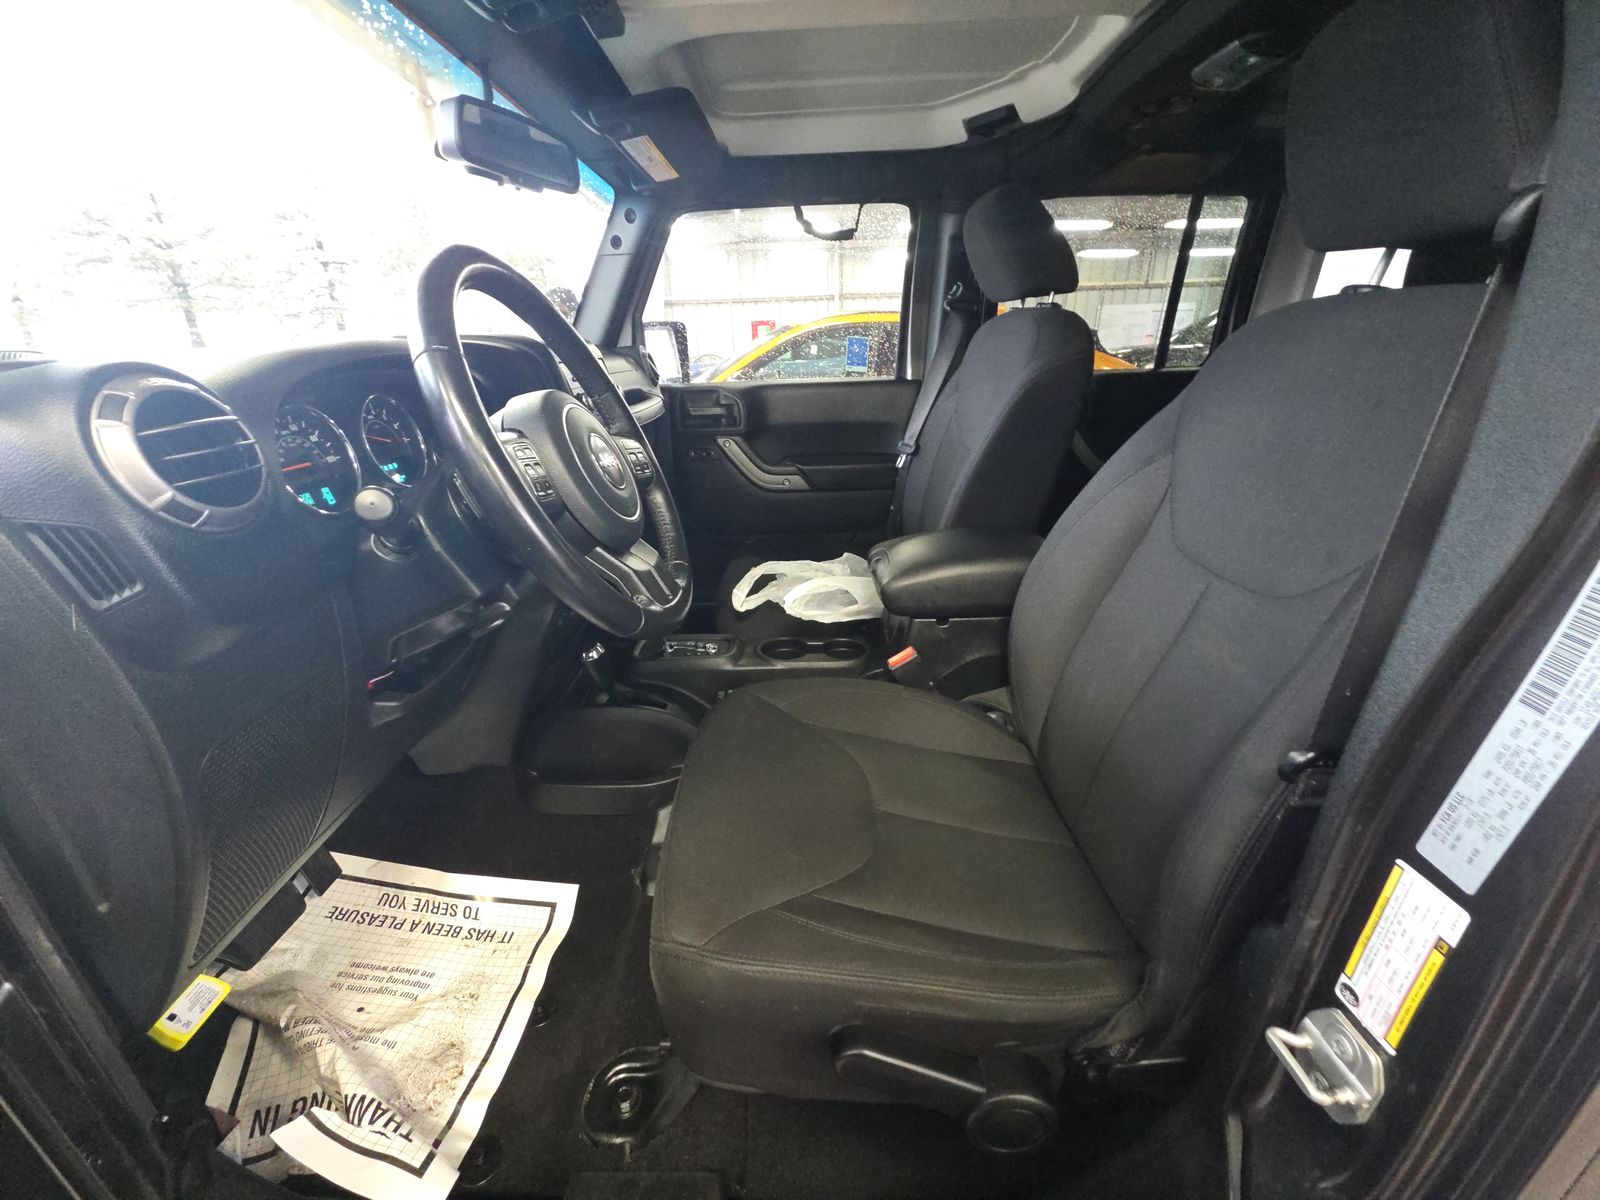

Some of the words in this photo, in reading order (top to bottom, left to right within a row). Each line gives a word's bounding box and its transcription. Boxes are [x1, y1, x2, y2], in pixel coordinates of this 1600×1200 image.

[377, 892, 407, 910] YOU
[411, 897, 459, 917] SERVE
[324, 905, 406, 931] PLEASURE
[463, 905, 480, 921] TO
[409, 919, 423, 933] A
[422, 922, 463, 938] BEEN
[464, 927, 497, 943] HAS
[497, 931, 515, 944] IT
[336, 971, 369, 981] service
[390, 965, 420, 976] always
[421, 970, 436, 979] are
[369, 975, 386, 983] our
[386, 975, 431, 991] improving
[345, 984, 399, 997] suggestions
[399, 990, 419, 1001] Your
[381, 1040, 398, 1050] the
[249, 1104, 281, 1139] IN
